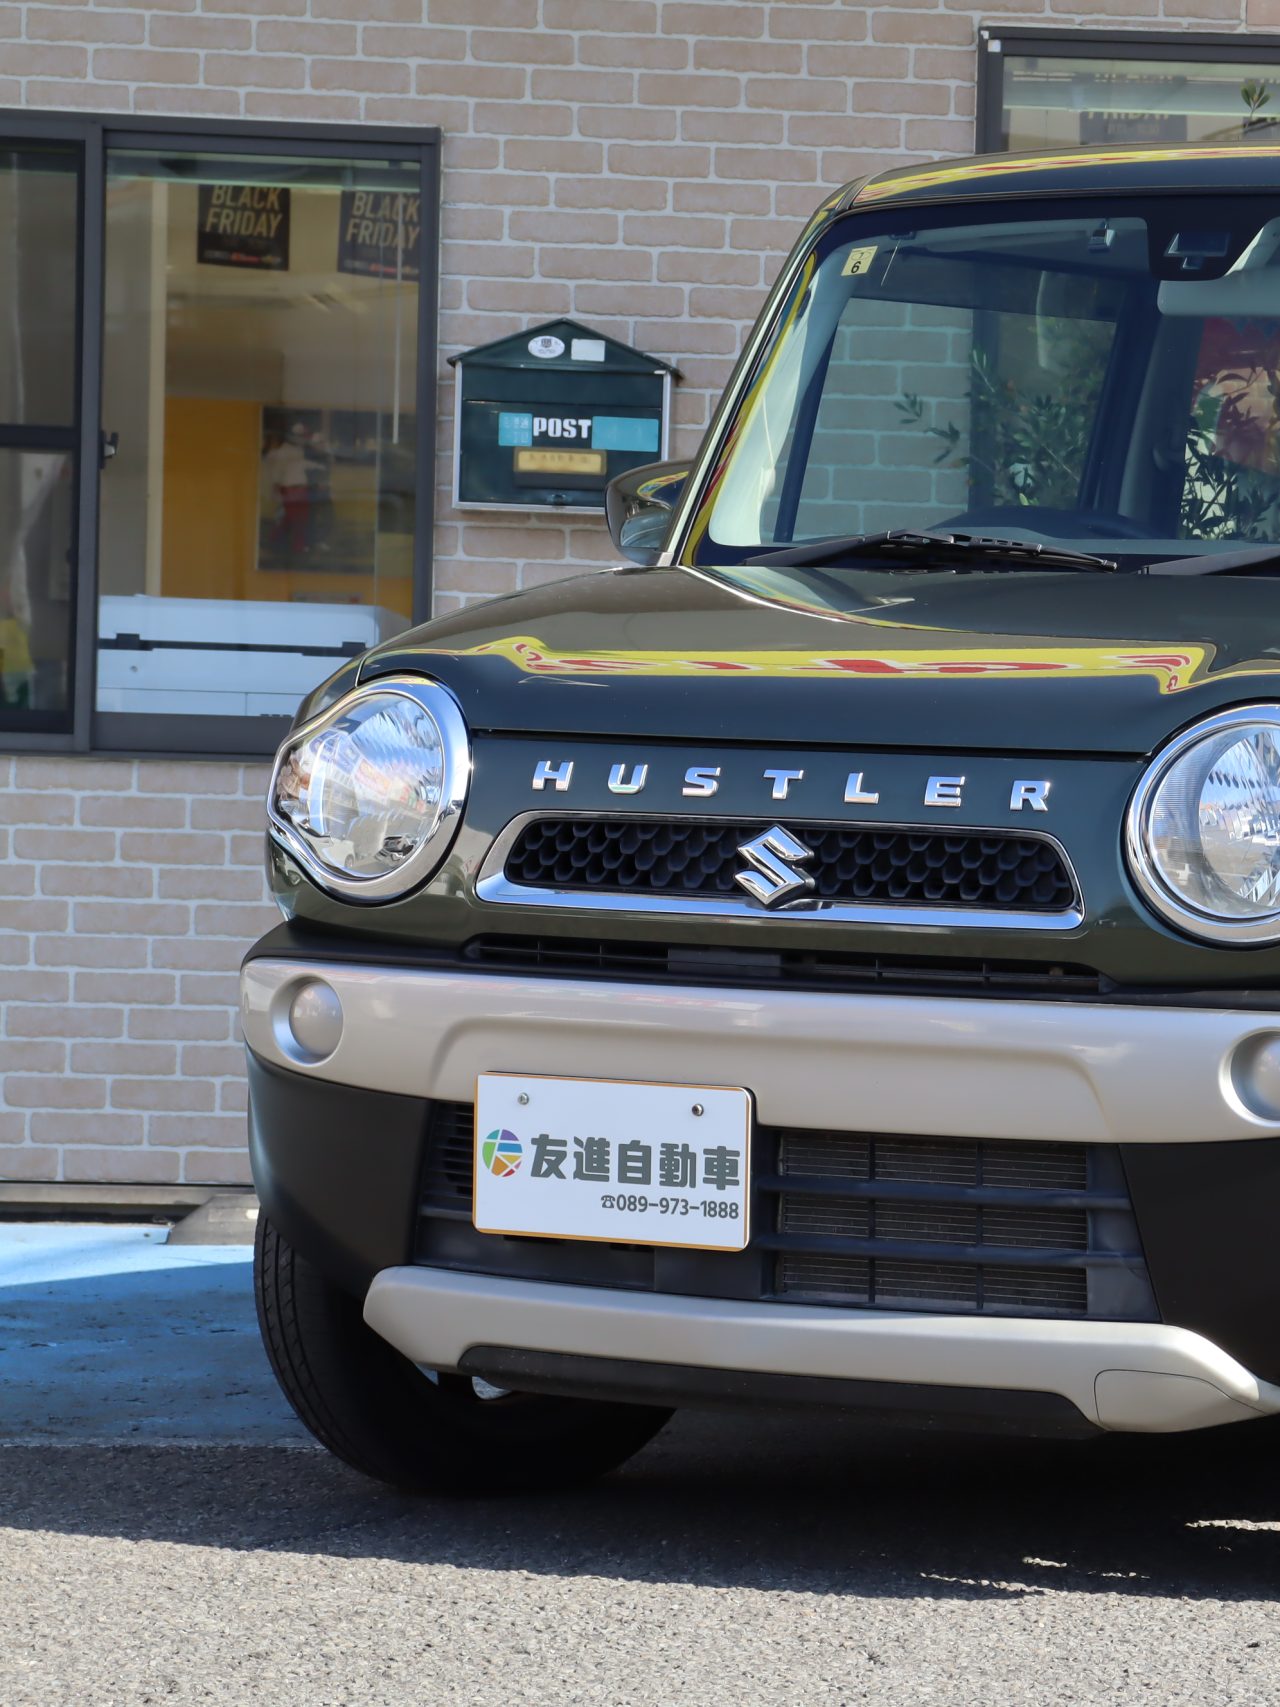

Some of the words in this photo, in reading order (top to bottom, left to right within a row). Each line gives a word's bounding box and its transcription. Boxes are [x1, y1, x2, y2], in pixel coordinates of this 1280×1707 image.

[211, 185, 282, 211] BLACK
[352, 192, 421, 223] BLACK
[205, 207, 283, 238] FRIDAY
[345, 218, 421, 250] FRIDAY
[851, 261, 861, 273] 6
[533, 417, 592, 440] POST
[531, 760, 1051, 813] HUSTLER
[530, 1133, 740, 1190] 友進自動車
[616, 1194, 740, 1219] 089-973-1888
